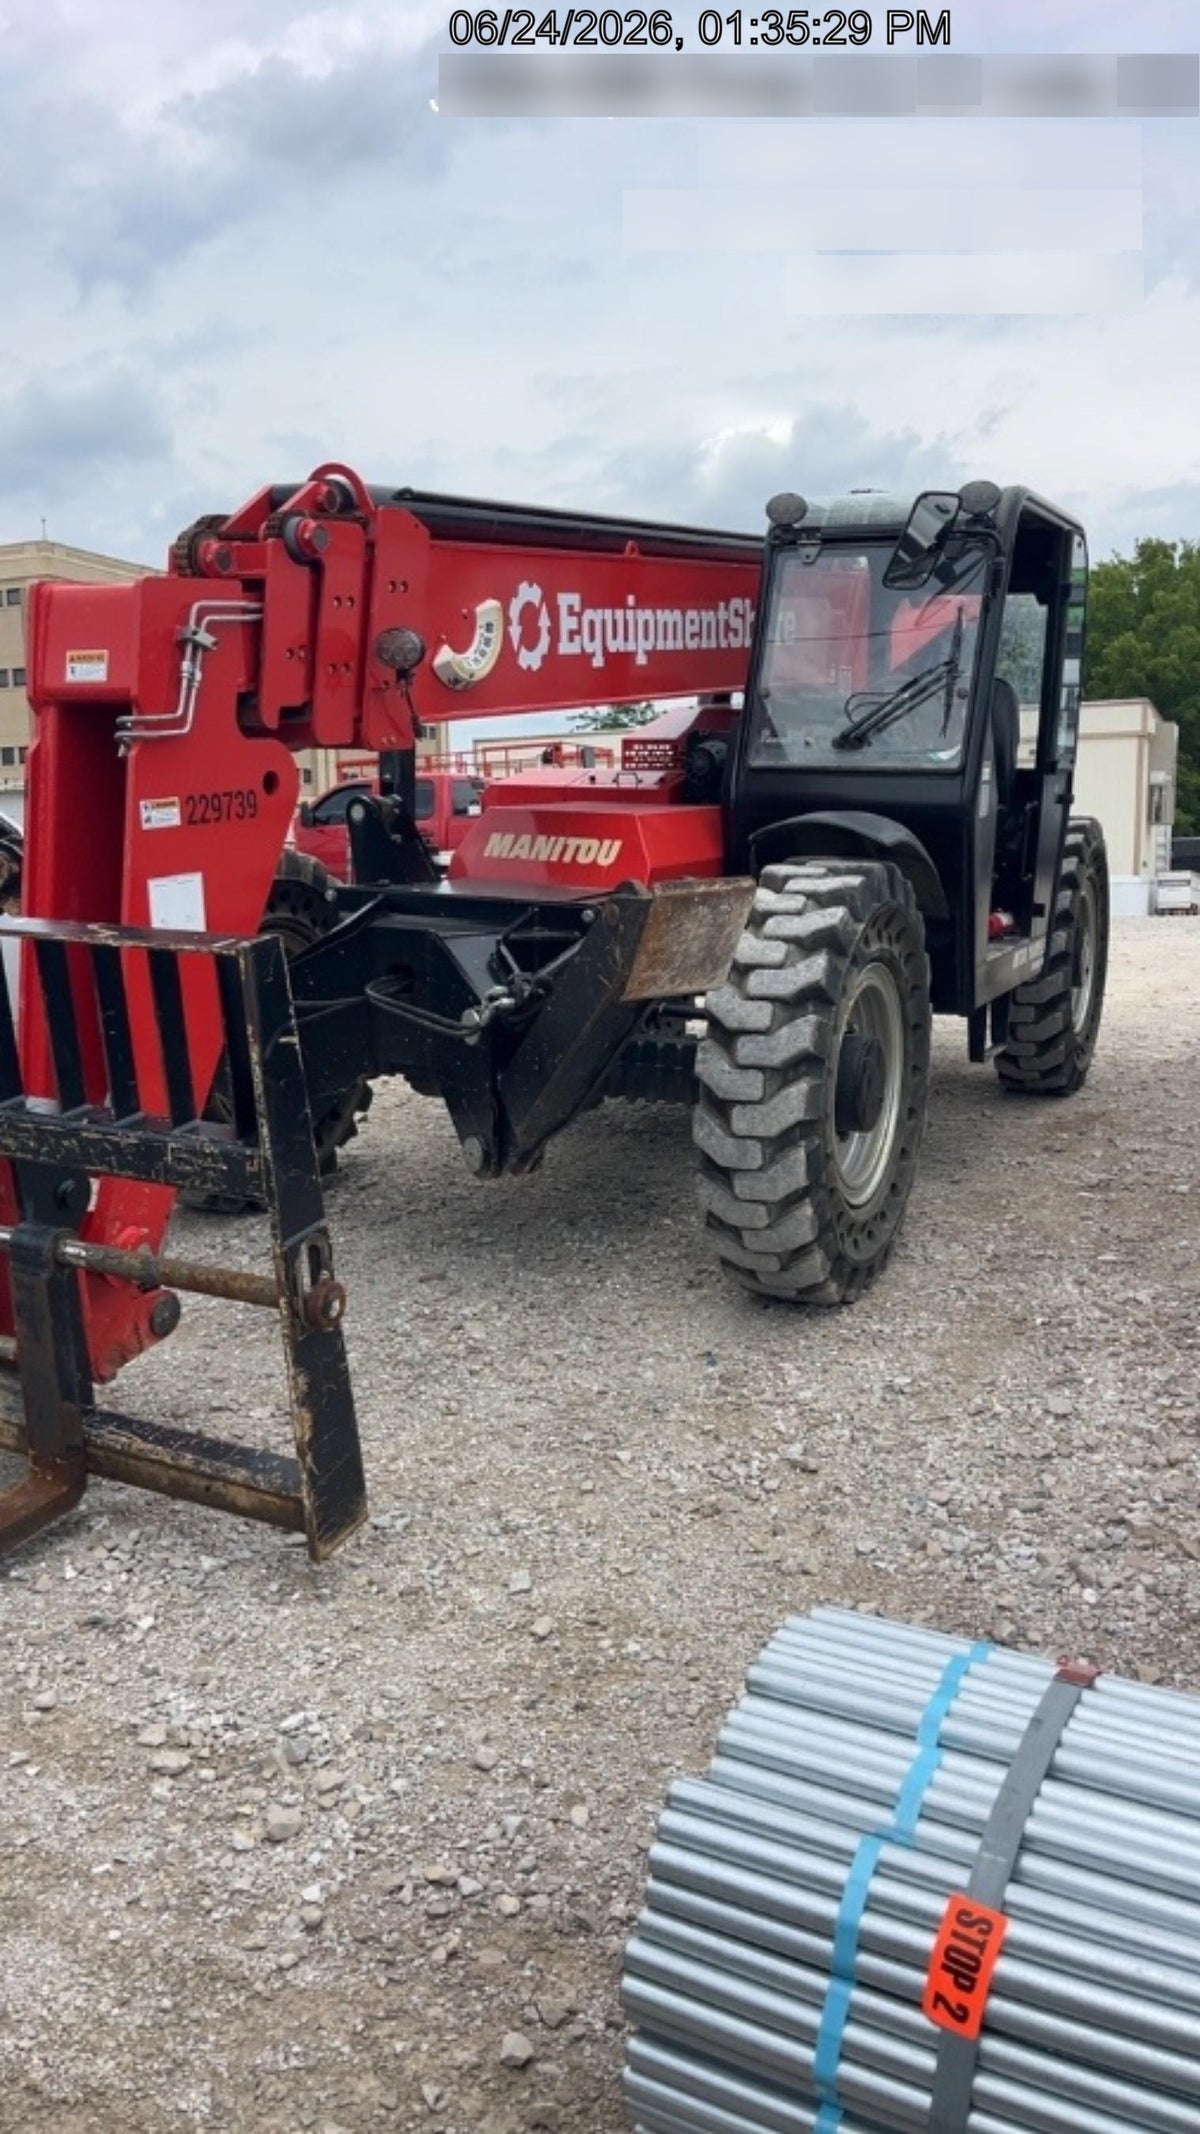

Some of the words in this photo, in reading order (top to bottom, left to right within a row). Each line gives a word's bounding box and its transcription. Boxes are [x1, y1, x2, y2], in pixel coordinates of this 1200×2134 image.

[186, 790, 257, 825] 229739
[484, 832, 622, 867] MANITOU
[941, 1908, 993, 1994] STOP
[931, 1991, 970, 2024] 2
